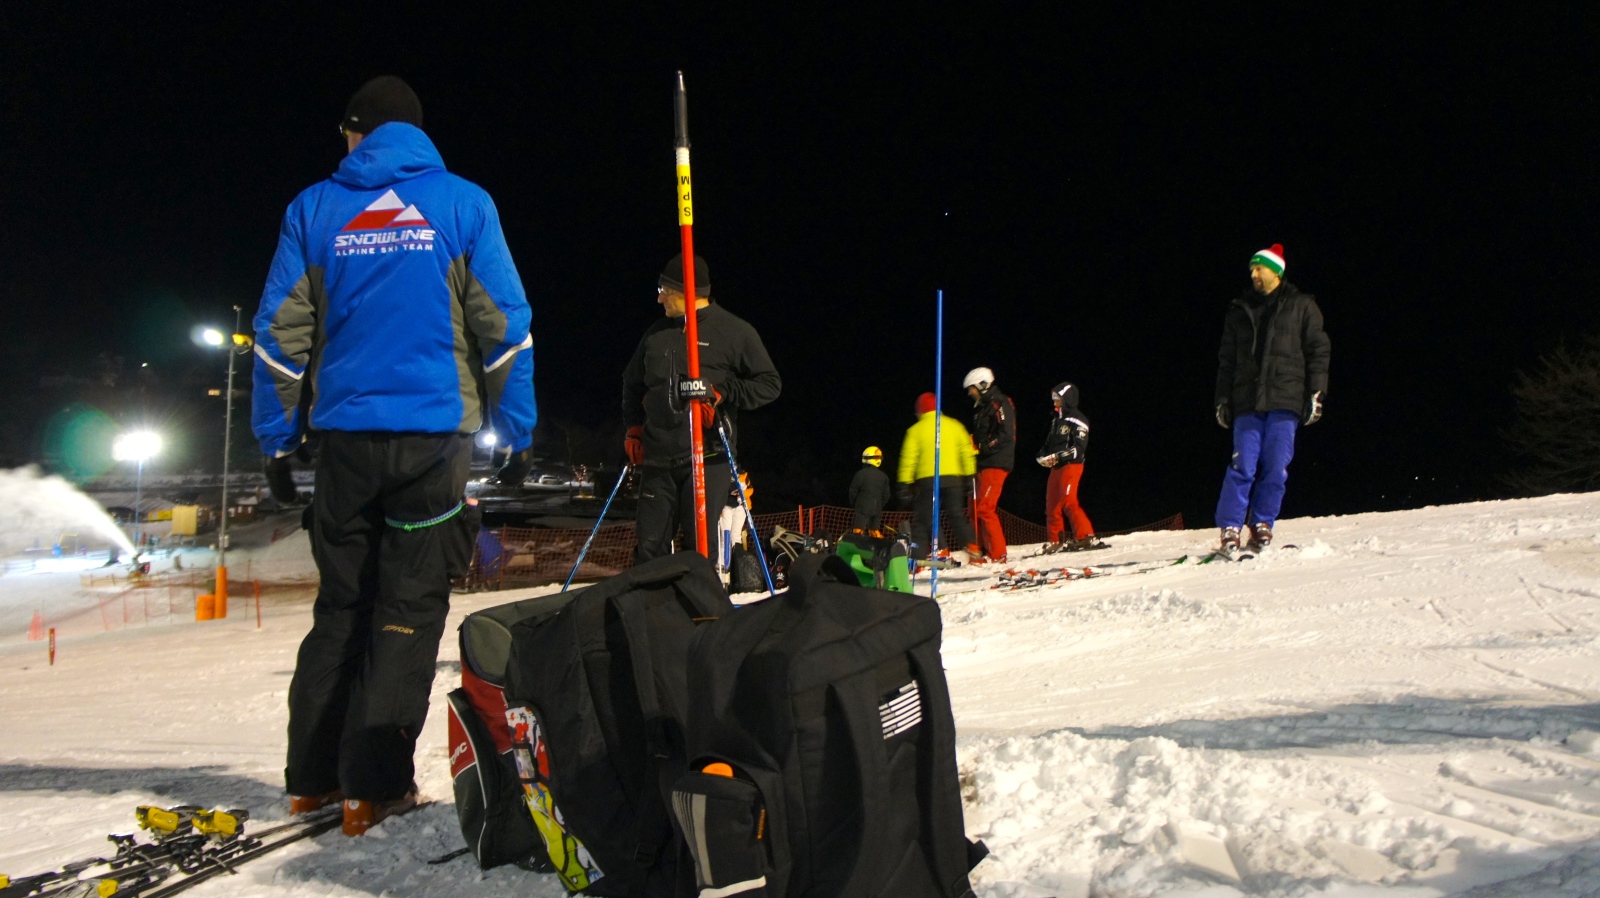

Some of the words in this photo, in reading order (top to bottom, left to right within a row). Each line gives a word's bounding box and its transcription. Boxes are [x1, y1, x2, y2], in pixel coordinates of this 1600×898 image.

[334, 229, 436, 247] SNOWLINE
[336, 247, 375, 257] ALPINE
[381, 245, 398, 254] SKI
[402, 243, 433, 251] TEAM
